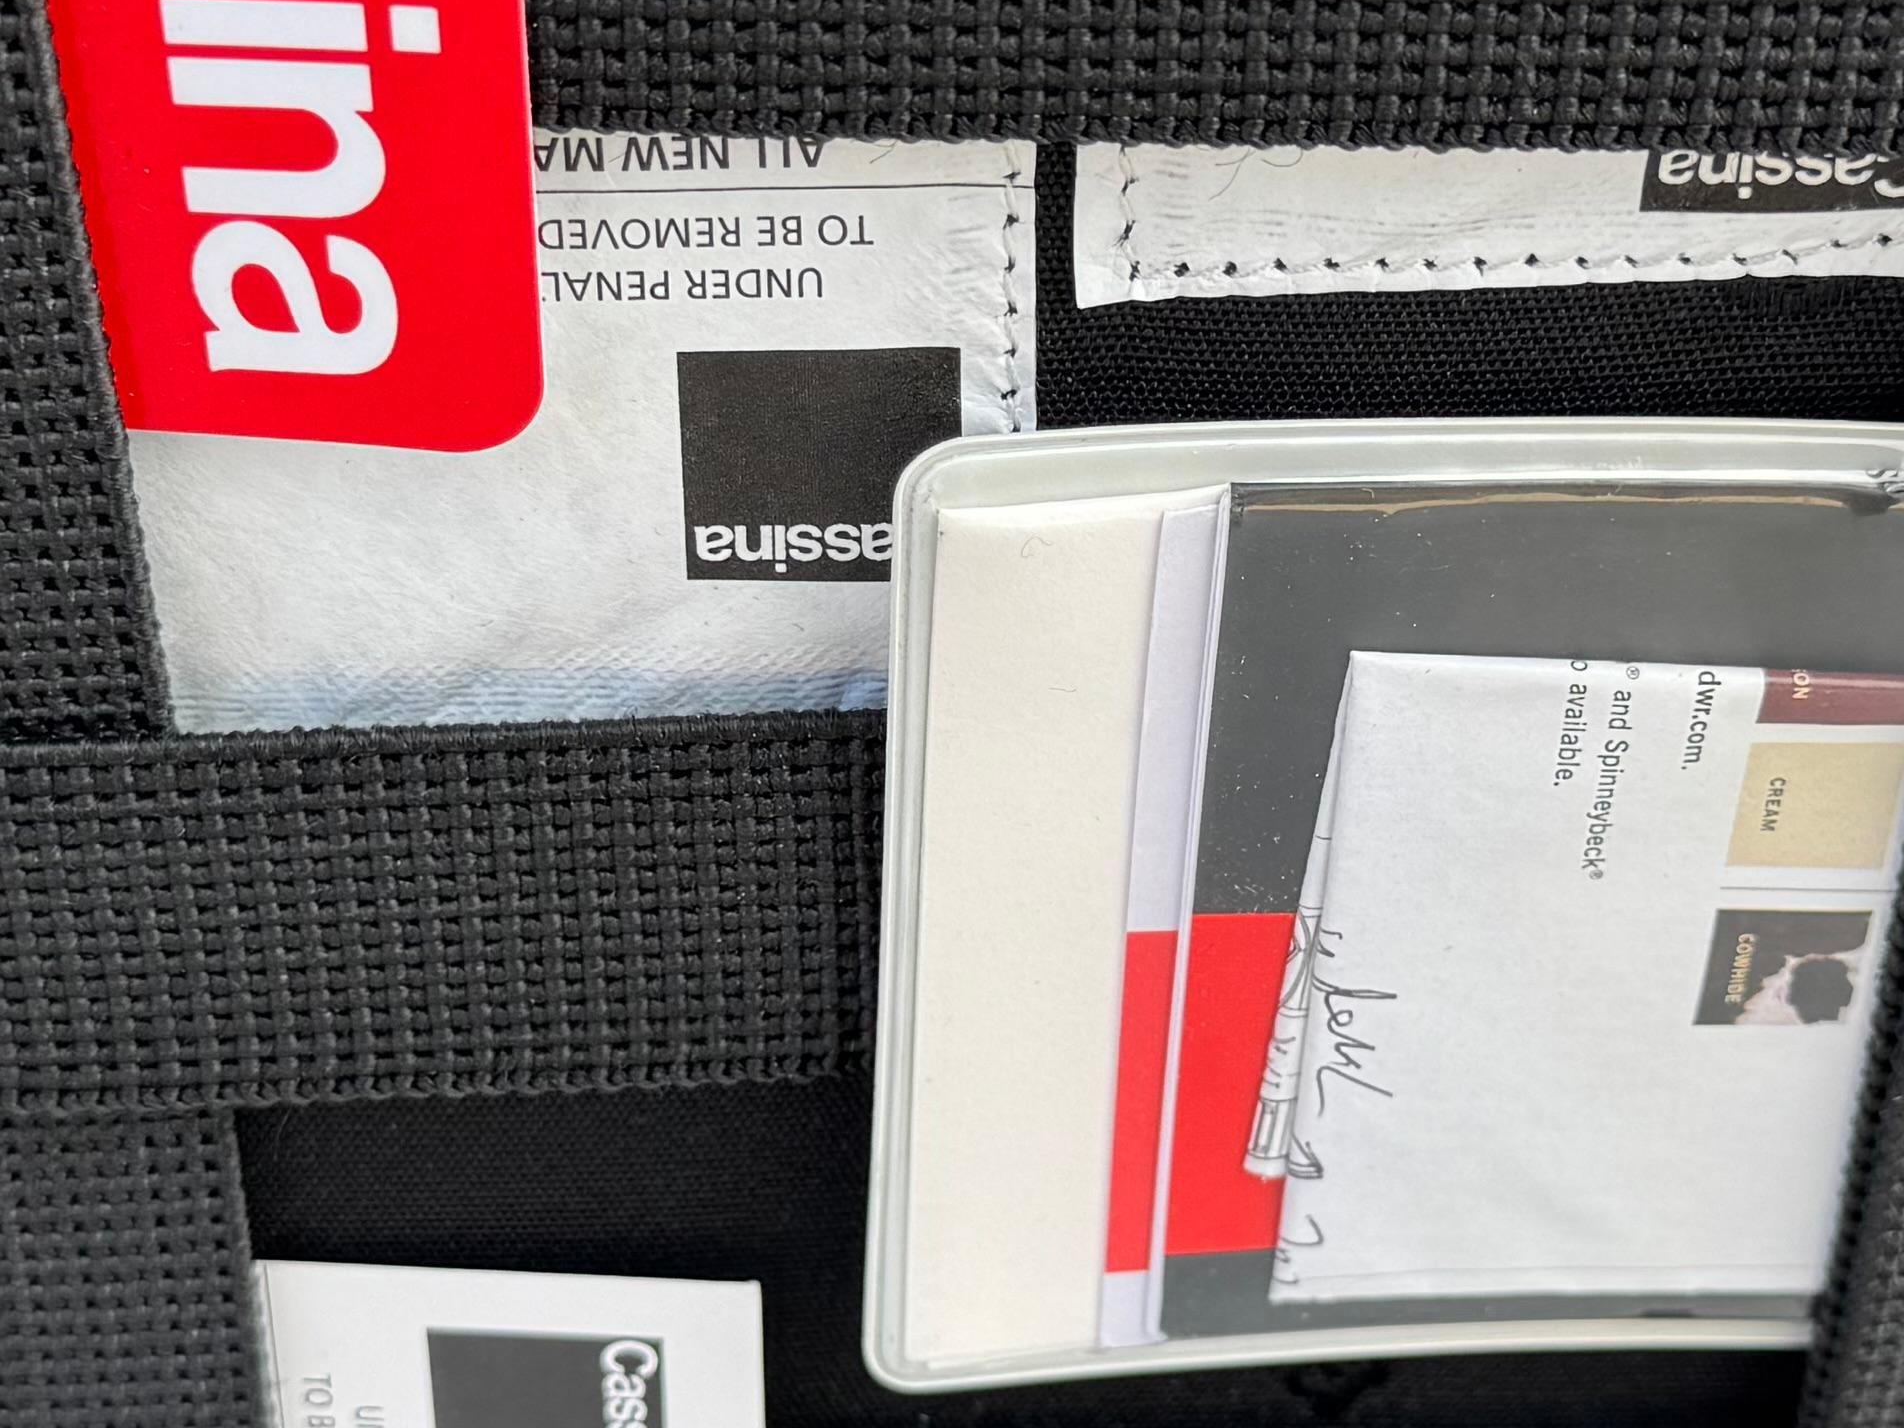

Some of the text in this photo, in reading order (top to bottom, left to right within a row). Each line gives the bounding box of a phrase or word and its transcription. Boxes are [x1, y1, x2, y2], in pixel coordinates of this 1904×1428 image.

[621, 137, 728, 170] NEW
[745, 137, 823, 167] ALL
[538, 215, 873, 249] TO BE REMOVED
[541, 268, 822, 300] UNDER PENAL
[1792, 669, 1811, 700] ON
[1608, 690, 1631, 729] and
[1681, 671, 1721, 770] dwr.com.
[1554, 684, 1589, 786] available.
[1760, 777, 1786, 832] CREAM
[1725, 933, 1757, 1004] COWHIDE
[303, 1374, 332, 1407] TO
